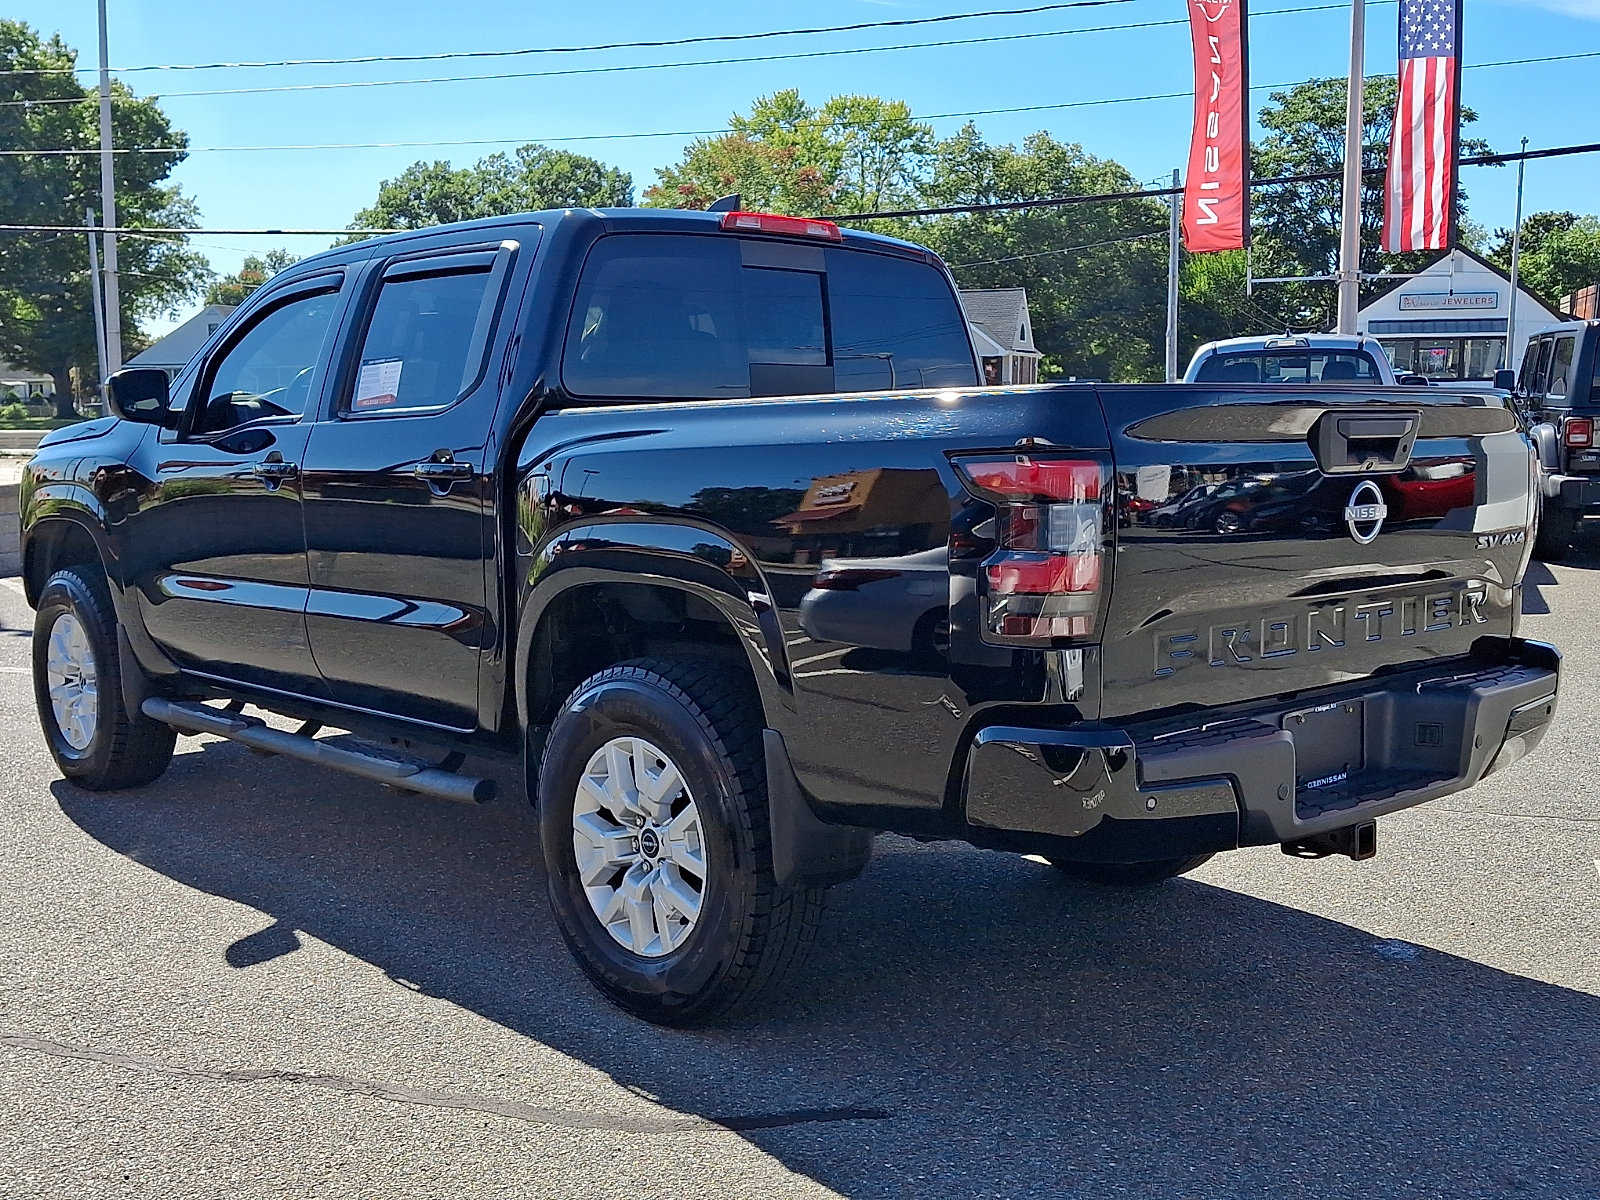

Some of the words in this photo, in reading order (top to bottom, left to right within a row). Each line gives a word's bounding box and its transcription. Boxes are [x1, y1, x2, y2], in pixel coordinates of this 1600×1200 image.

[1441, 297, 1494, 305] JEWELERS
[1346, 506, 1387, 520] NISSAN
[1475, 534, 1499, 550] SV
[1151, 586, 1489, 677] FRONTIER
